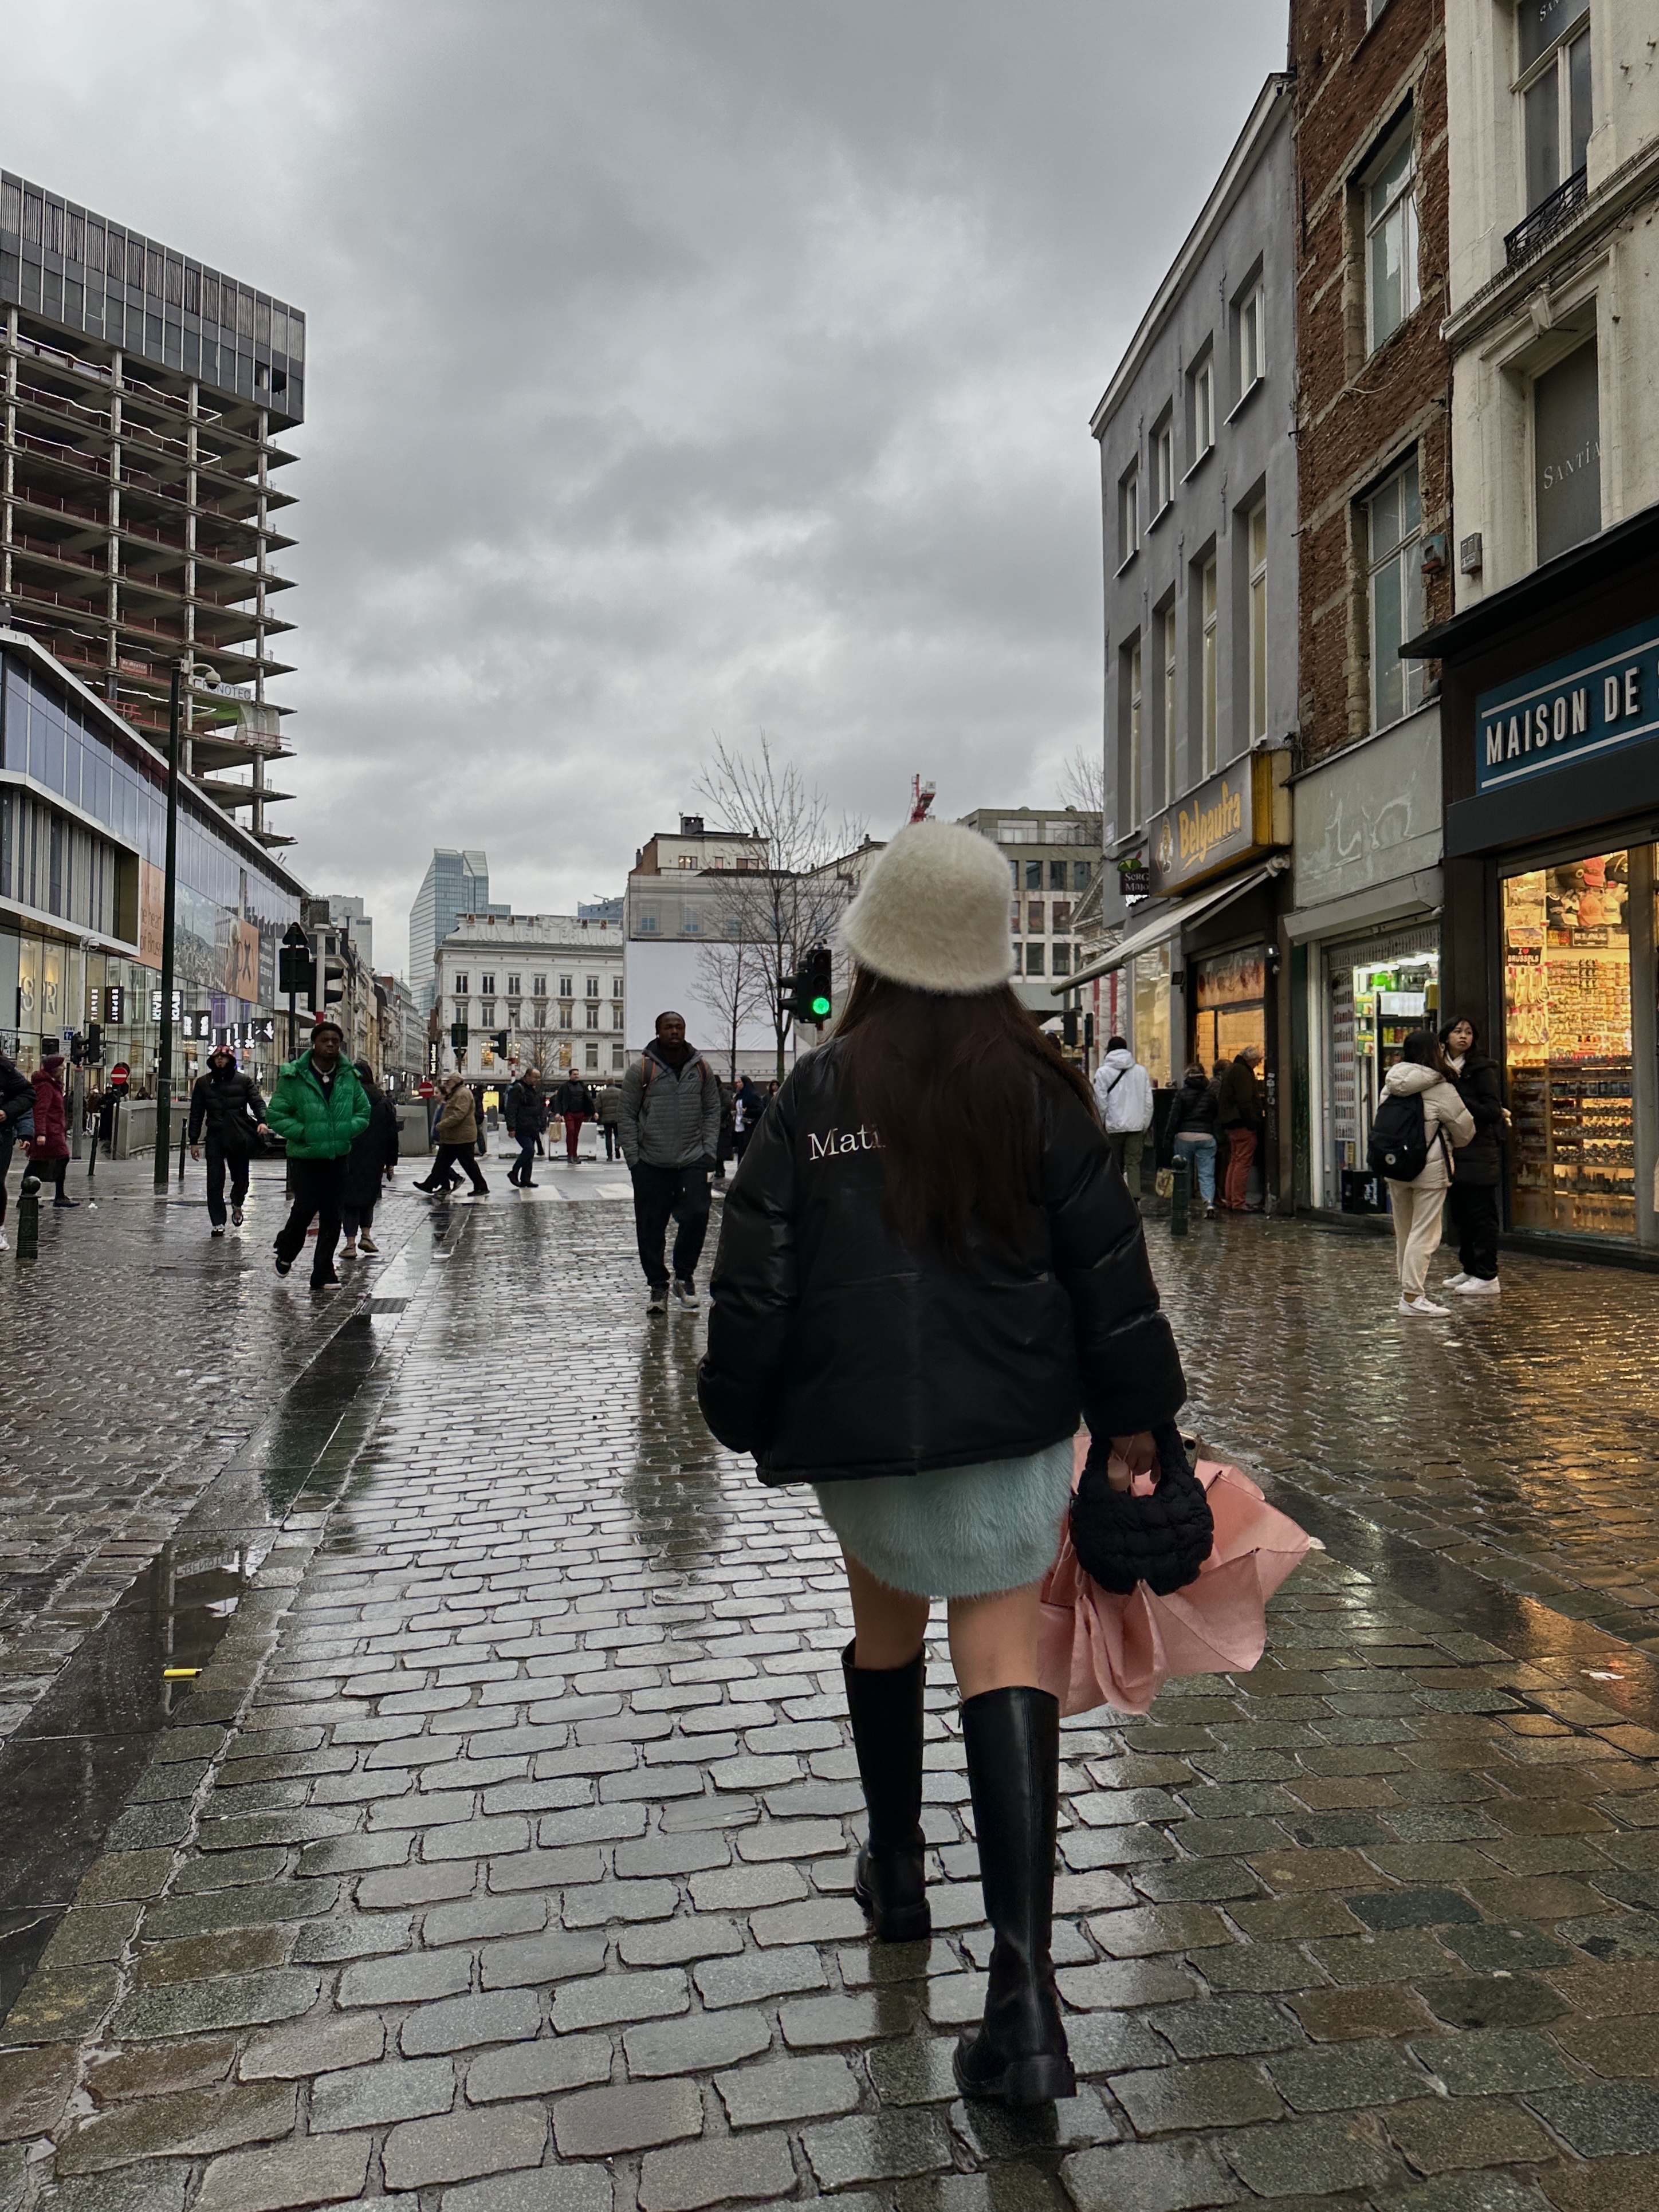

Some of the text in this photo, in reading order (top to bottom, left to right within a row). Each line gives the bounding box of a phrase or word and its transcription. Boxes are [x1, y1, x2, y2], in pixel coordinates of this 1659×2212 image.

[203, 680, 251, 700] RNOTEC
[1486, 688, 1587, 766] MAISON
[1604, 667, 1640, 723] DE
[1179, 781, 1241, 863] Belgaufra
[140, 928, 147, 951] of
